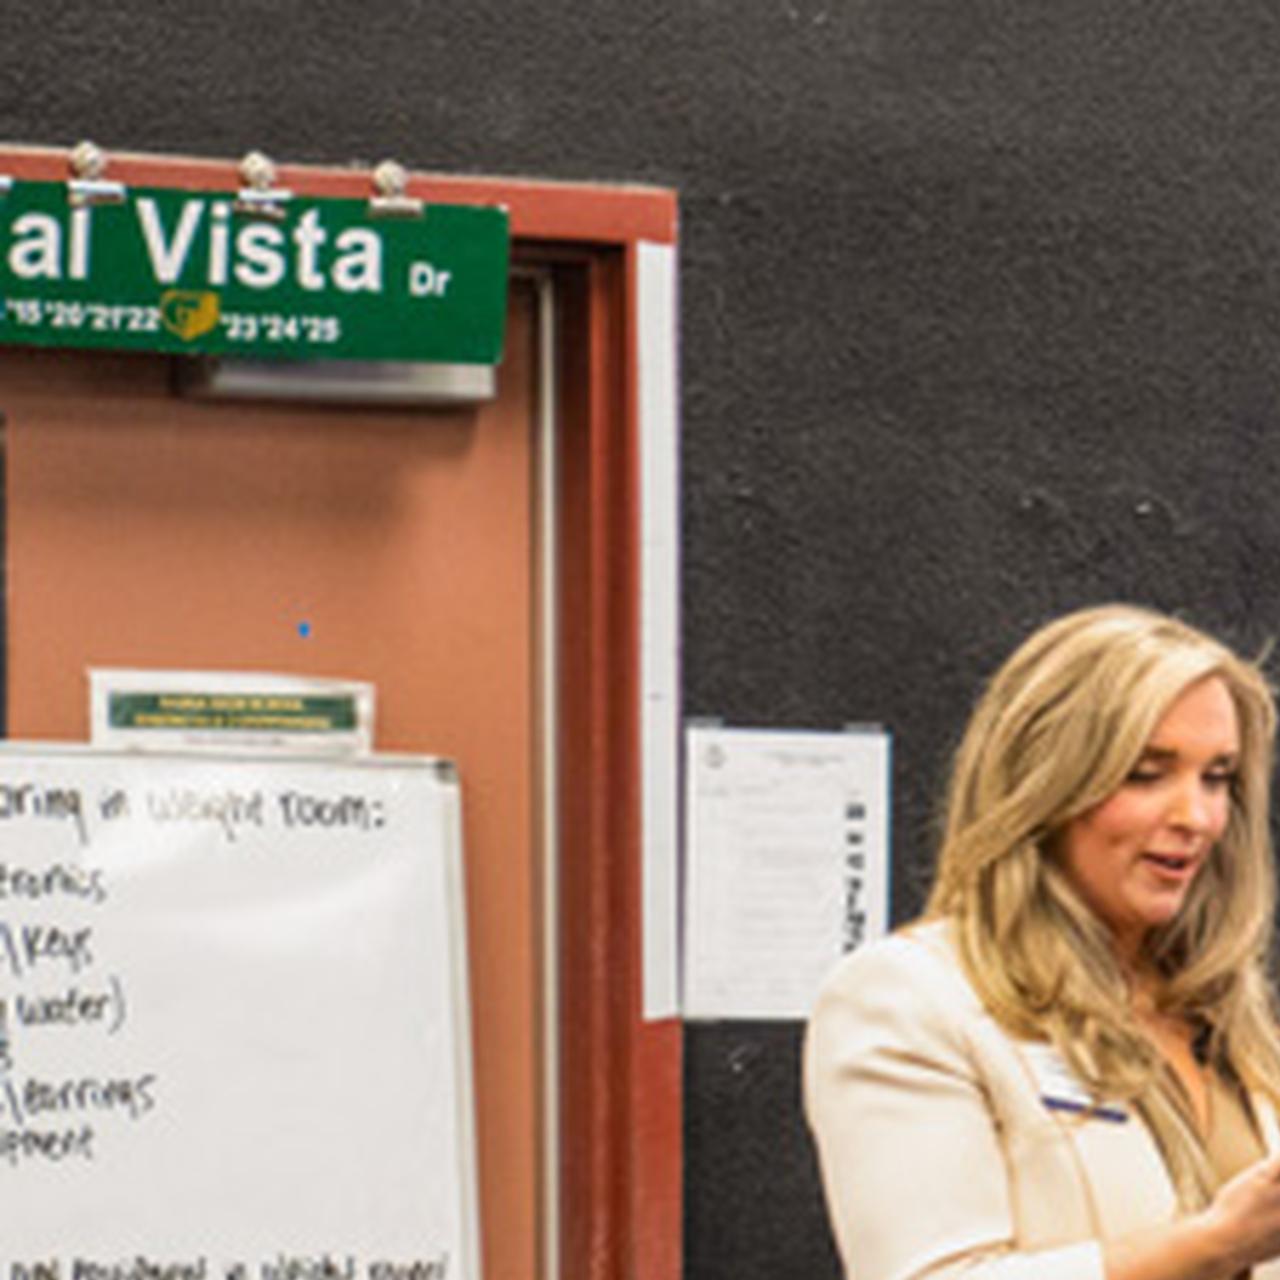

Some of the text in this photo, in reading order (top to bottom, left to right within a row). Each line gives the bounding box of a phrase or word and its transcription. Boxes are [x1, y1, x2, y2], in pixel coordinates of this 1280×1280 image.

[8, 197, 452, 296] al Vista Dr
[260, 313, 299, 342] '24
